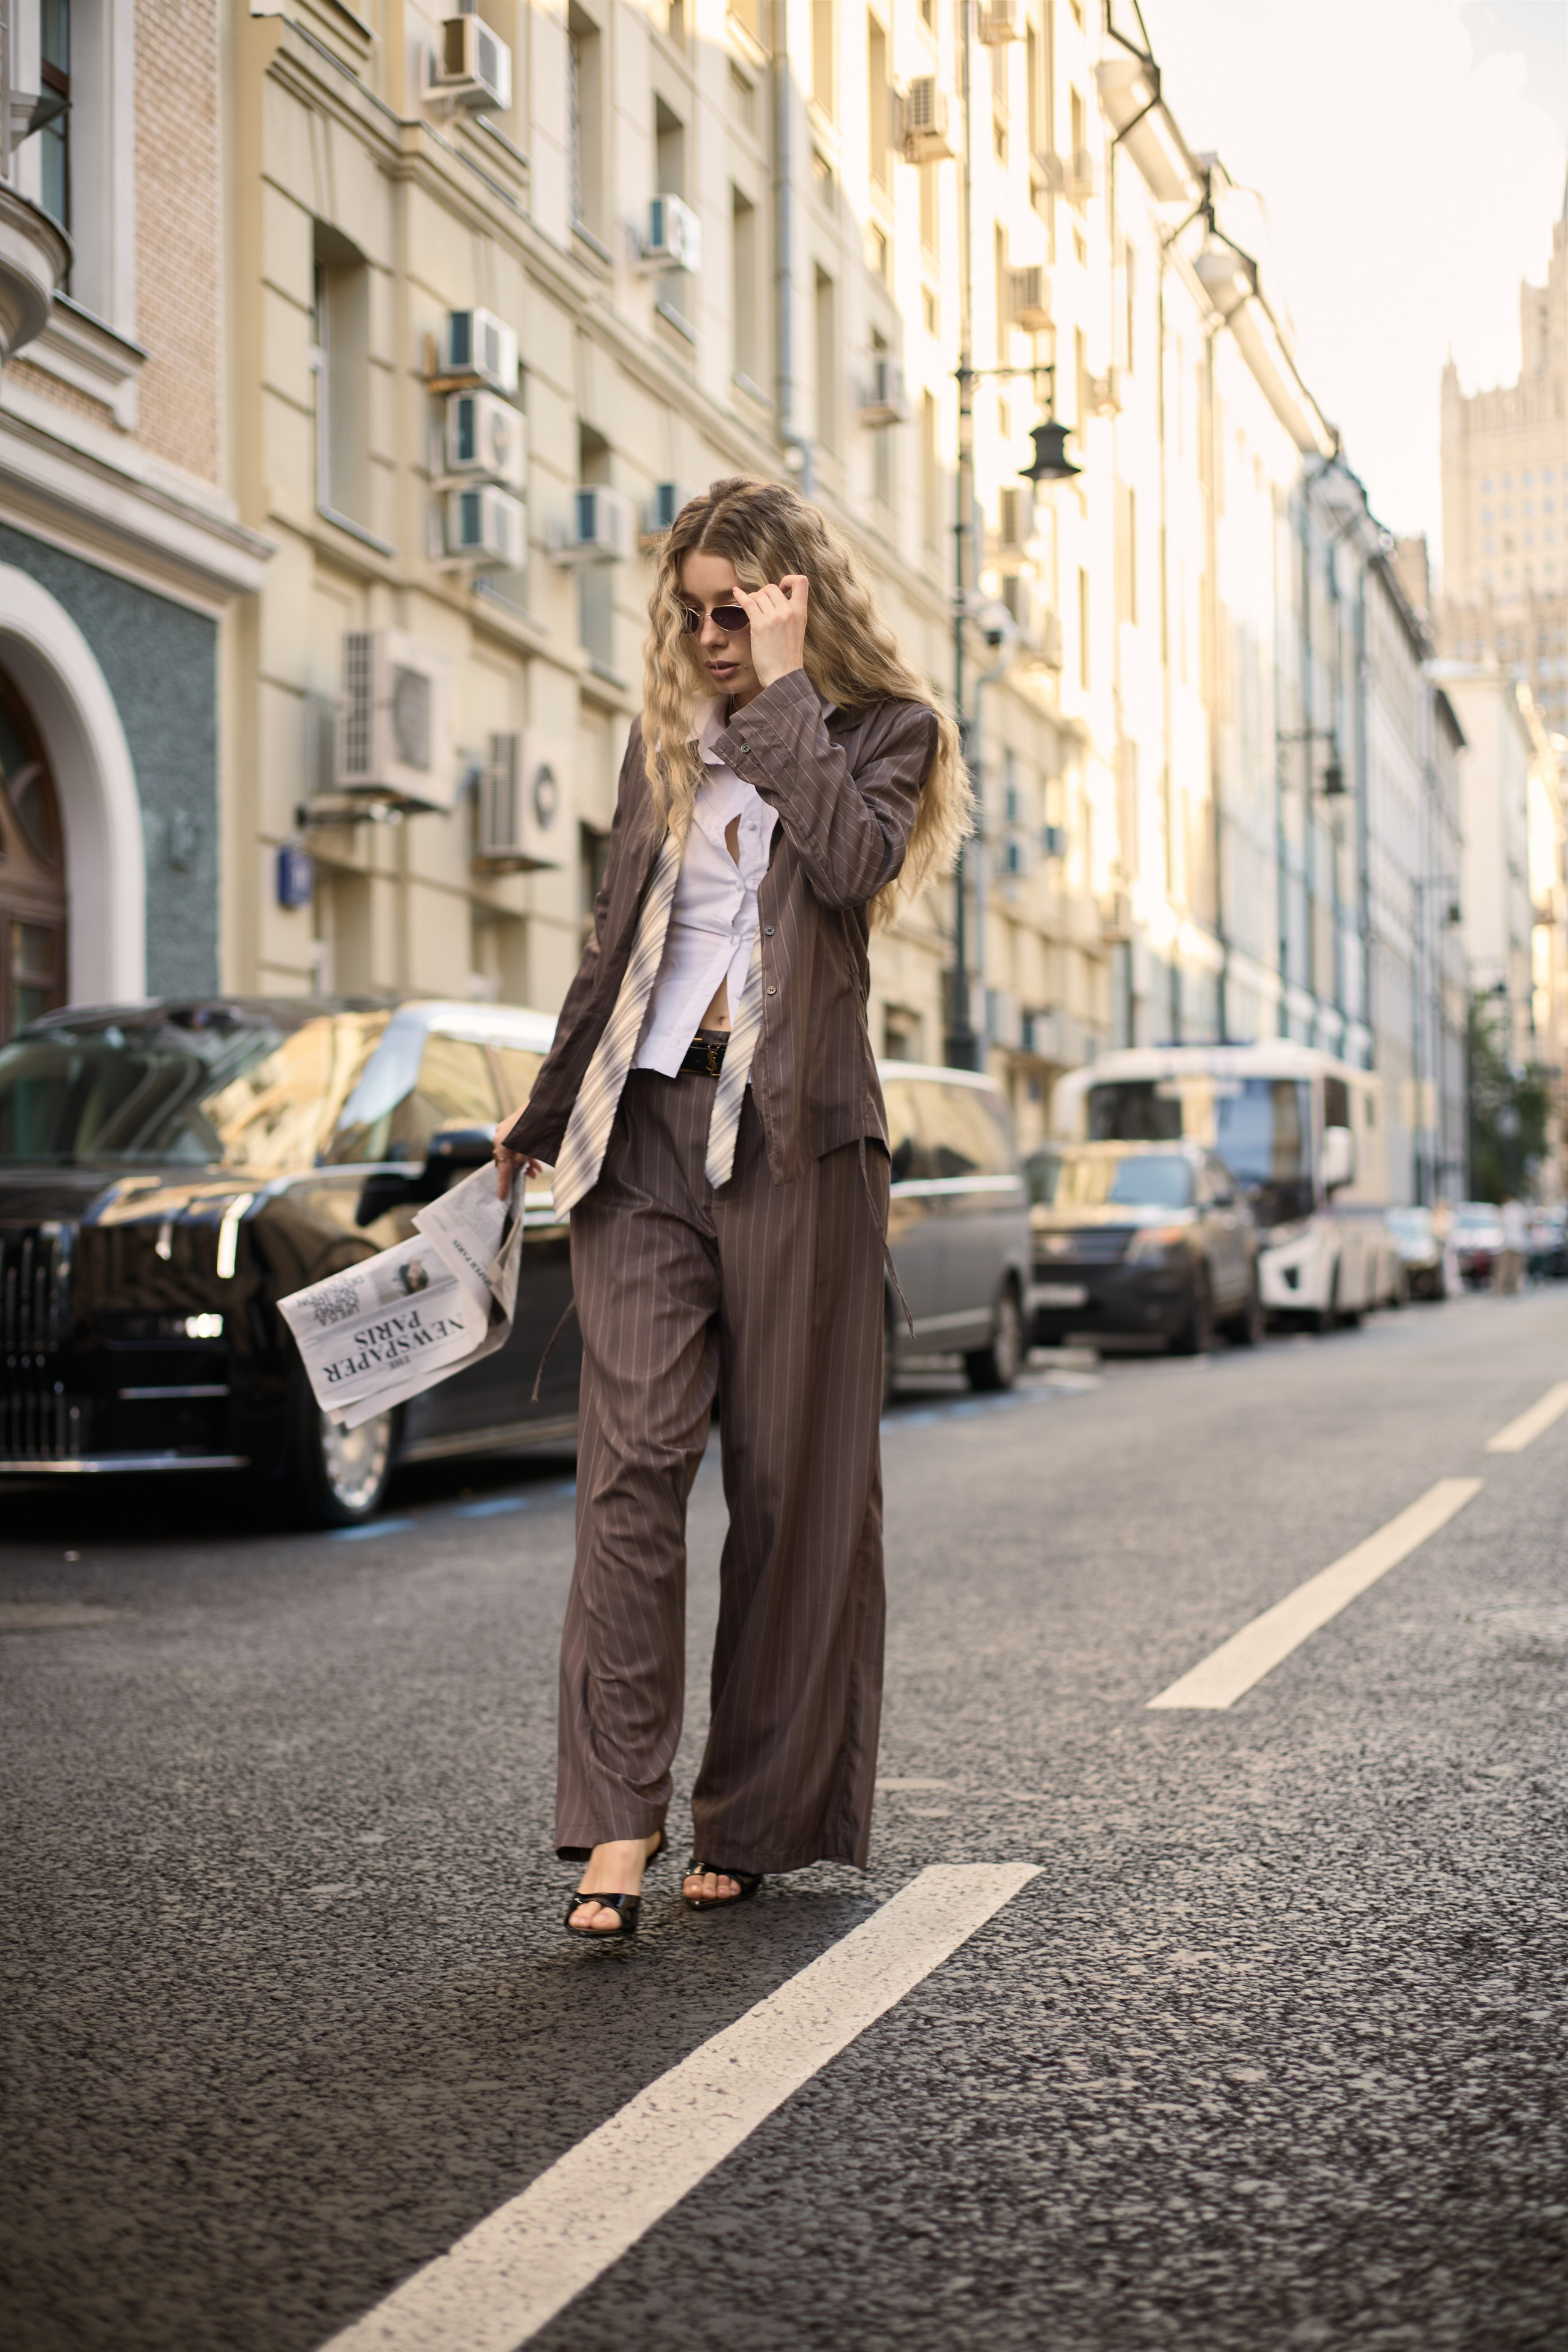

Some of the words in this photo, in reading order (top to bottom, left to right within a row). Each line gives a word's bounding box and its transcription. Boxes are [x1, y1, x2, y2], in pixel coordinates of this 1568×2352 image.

[453, 1239, 472, 1262] PARIS
[353, 1310, 421, 1349] PARIS
[322, 1314, 465, 1382] NEWSPAPER
[388, 1355, 411, 1370] THE
